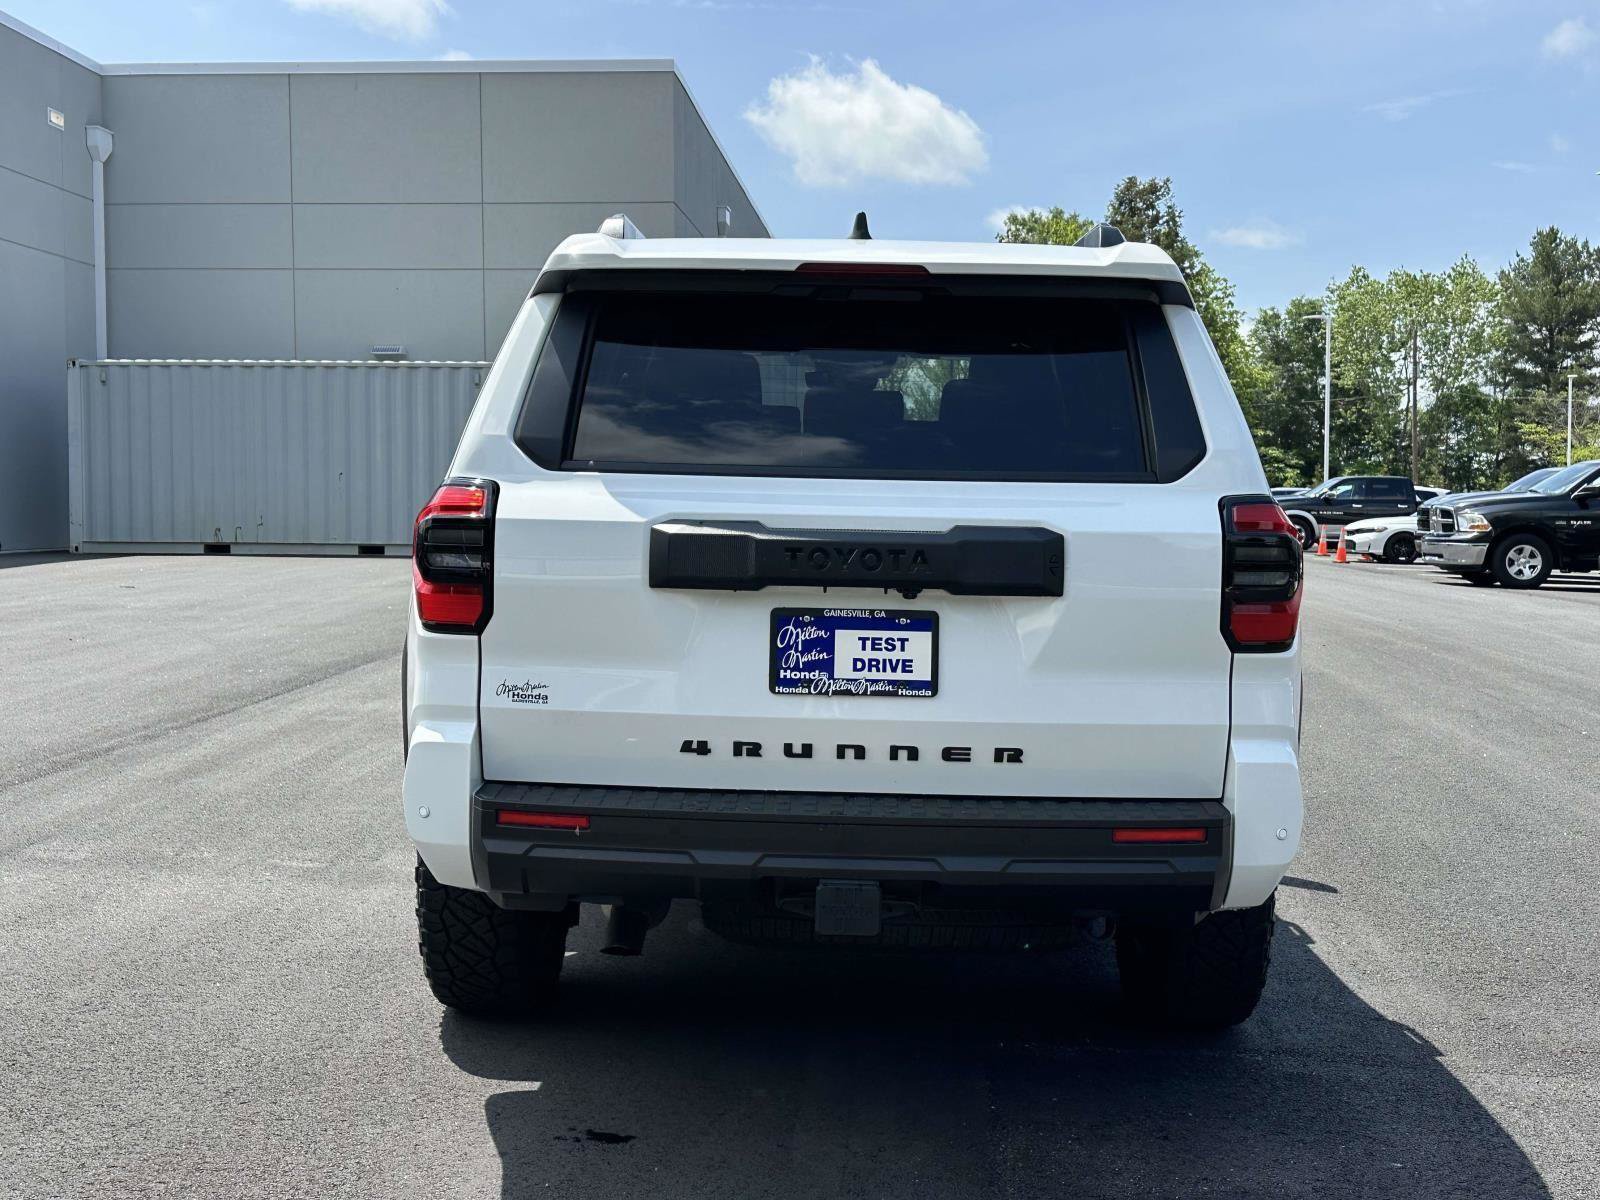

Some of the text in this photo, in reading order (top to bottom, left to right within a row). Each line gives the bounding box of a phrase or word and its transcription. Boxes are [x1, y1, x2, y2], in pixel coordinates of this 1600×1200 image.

[784, 547, 933, 574] TOYOTA
[823, 609, 872, 619] GAINESVILLE,
[777, 616, 830, 651] Milton
[858, 636, 910, 652] TEST
[782, 643, 833, 669] Martin
[852, 658, 914, 674] DRIVE
[512, 692, 548, 700] Honda
[775, 686, 809, 694] Honda
[898, 688, 932, 696] Honda
[679, 739, 1024, 763] 4RUNNER
